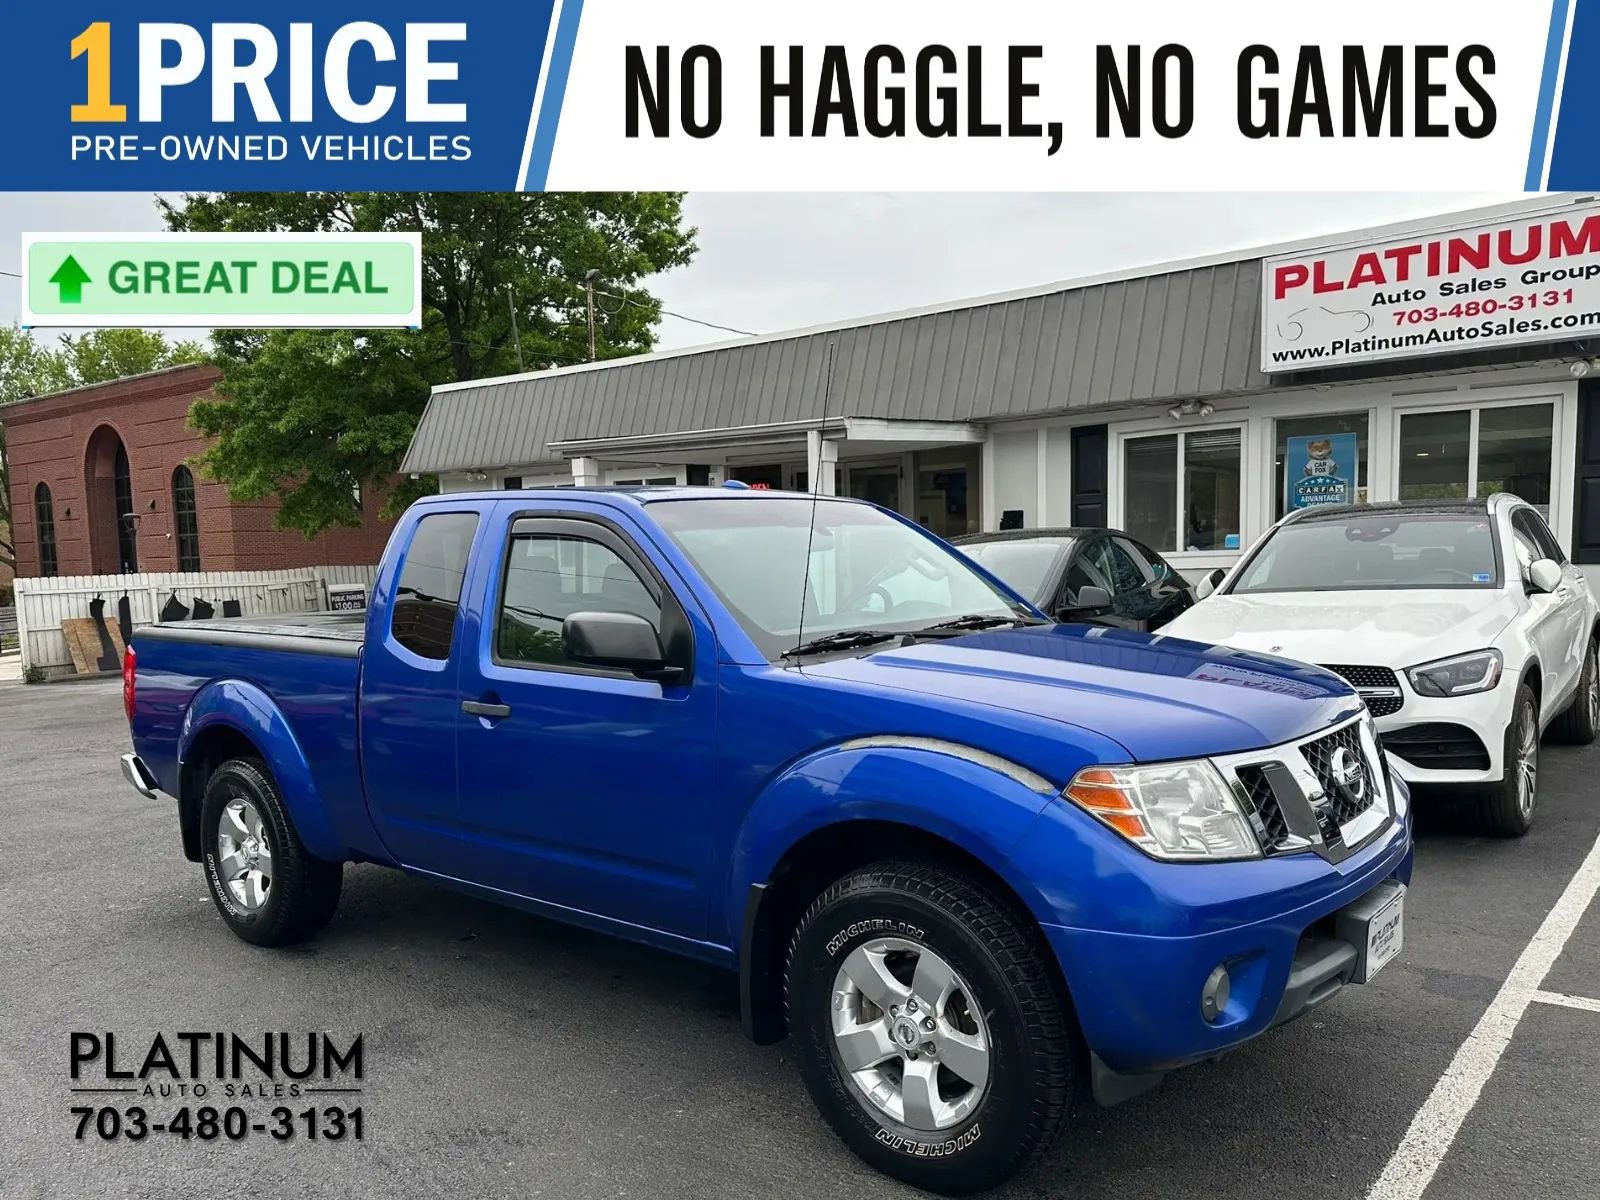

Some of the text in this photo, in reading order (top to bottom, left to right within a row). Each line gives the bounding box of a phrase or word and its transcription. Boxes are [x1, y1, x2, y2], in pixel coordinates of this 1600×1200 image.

[1274, 215, 1600, 300] PLATINUM
[1371, 263, 1600, 306] Auto Sales Group
[1392, 288, 1574, 326] 703-480-3131
[1272, 310, 1600, 362] www.PlatinumAutoSales.com
[1298, 485, 1344, 495] CARFAX
[1300, 494, 1341, 503] ADVANTAGE
[826, 919, 924, 956] MICHELIN
[875, 1123, 981, 1157] MICHELIN
